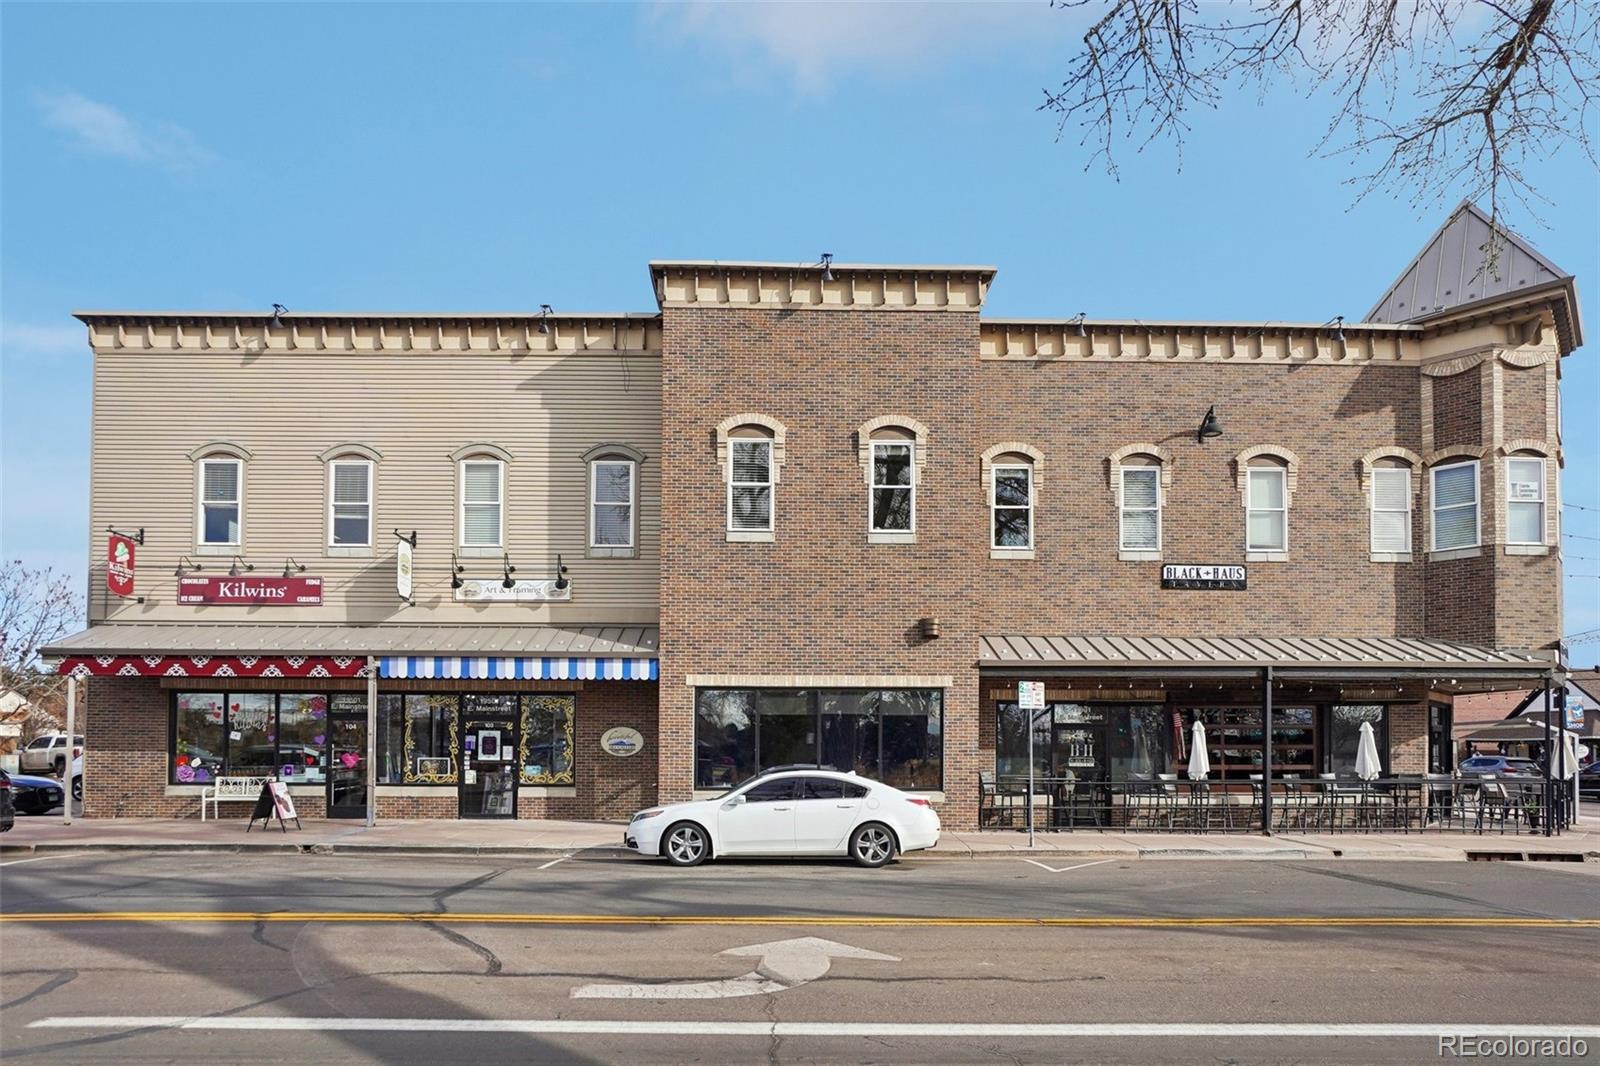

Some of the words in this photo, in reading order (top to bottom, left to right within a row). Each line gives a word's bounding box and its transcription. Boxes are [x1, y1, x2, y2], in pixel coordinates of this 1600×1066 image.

[1213, 567, 1243, 579] HAUS
[1171, 580, 1238, 588] TAVERN
[218, 582, 286, 598] Kilwins
[485, 586, 498, 594] Art
